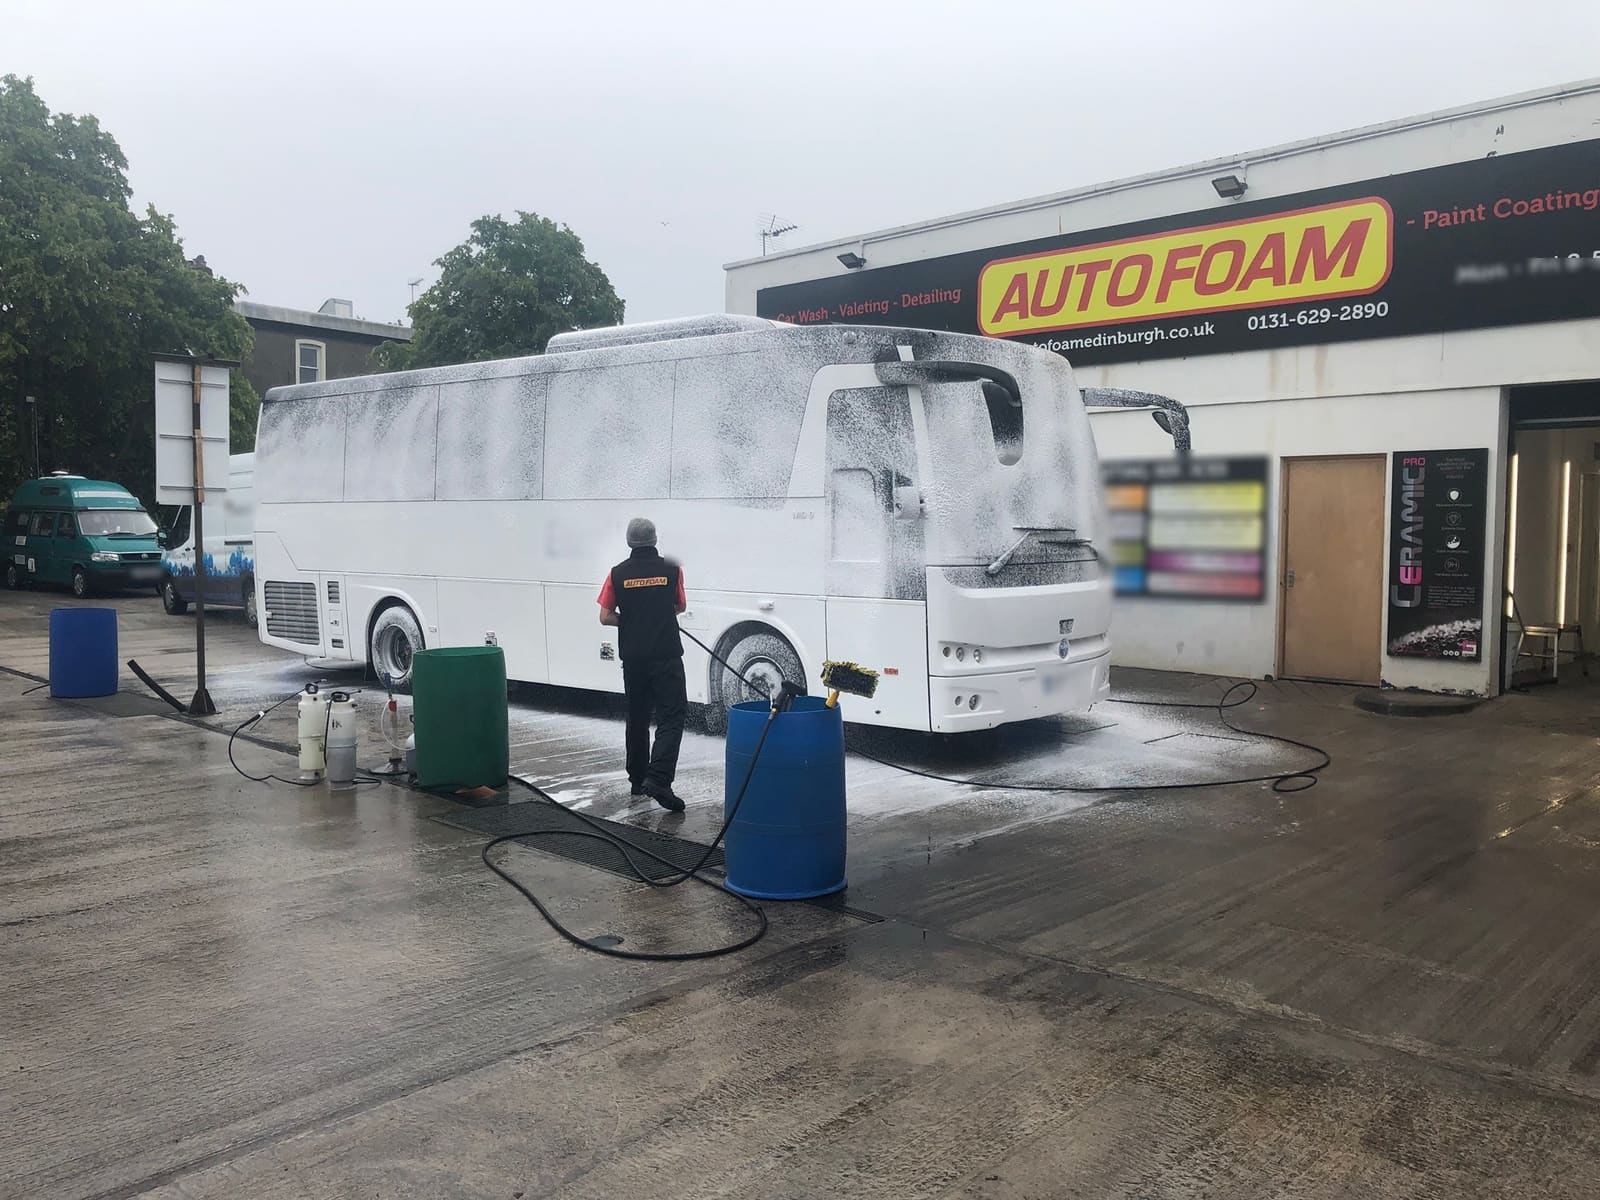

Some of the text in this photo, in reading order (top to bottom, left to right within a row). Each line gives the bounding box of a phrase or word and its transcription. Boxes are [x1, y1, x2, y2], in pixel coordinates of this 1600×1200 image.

[1423, 203, 1486, 230] Paint
[1493, 188, 1600, 218] Coating
[776, 313, 796, 324] Car
[798, 307, 829, 323] Wash
[839, 299, 890, 318] Valeting
[901, 288, 962, 308] Detailing
[1247, 301, 1389, 331] 0131-629-2890
[1402, 457, 1426, 467] PRO
[1391, 467, 1426, 608] CERAMIC
